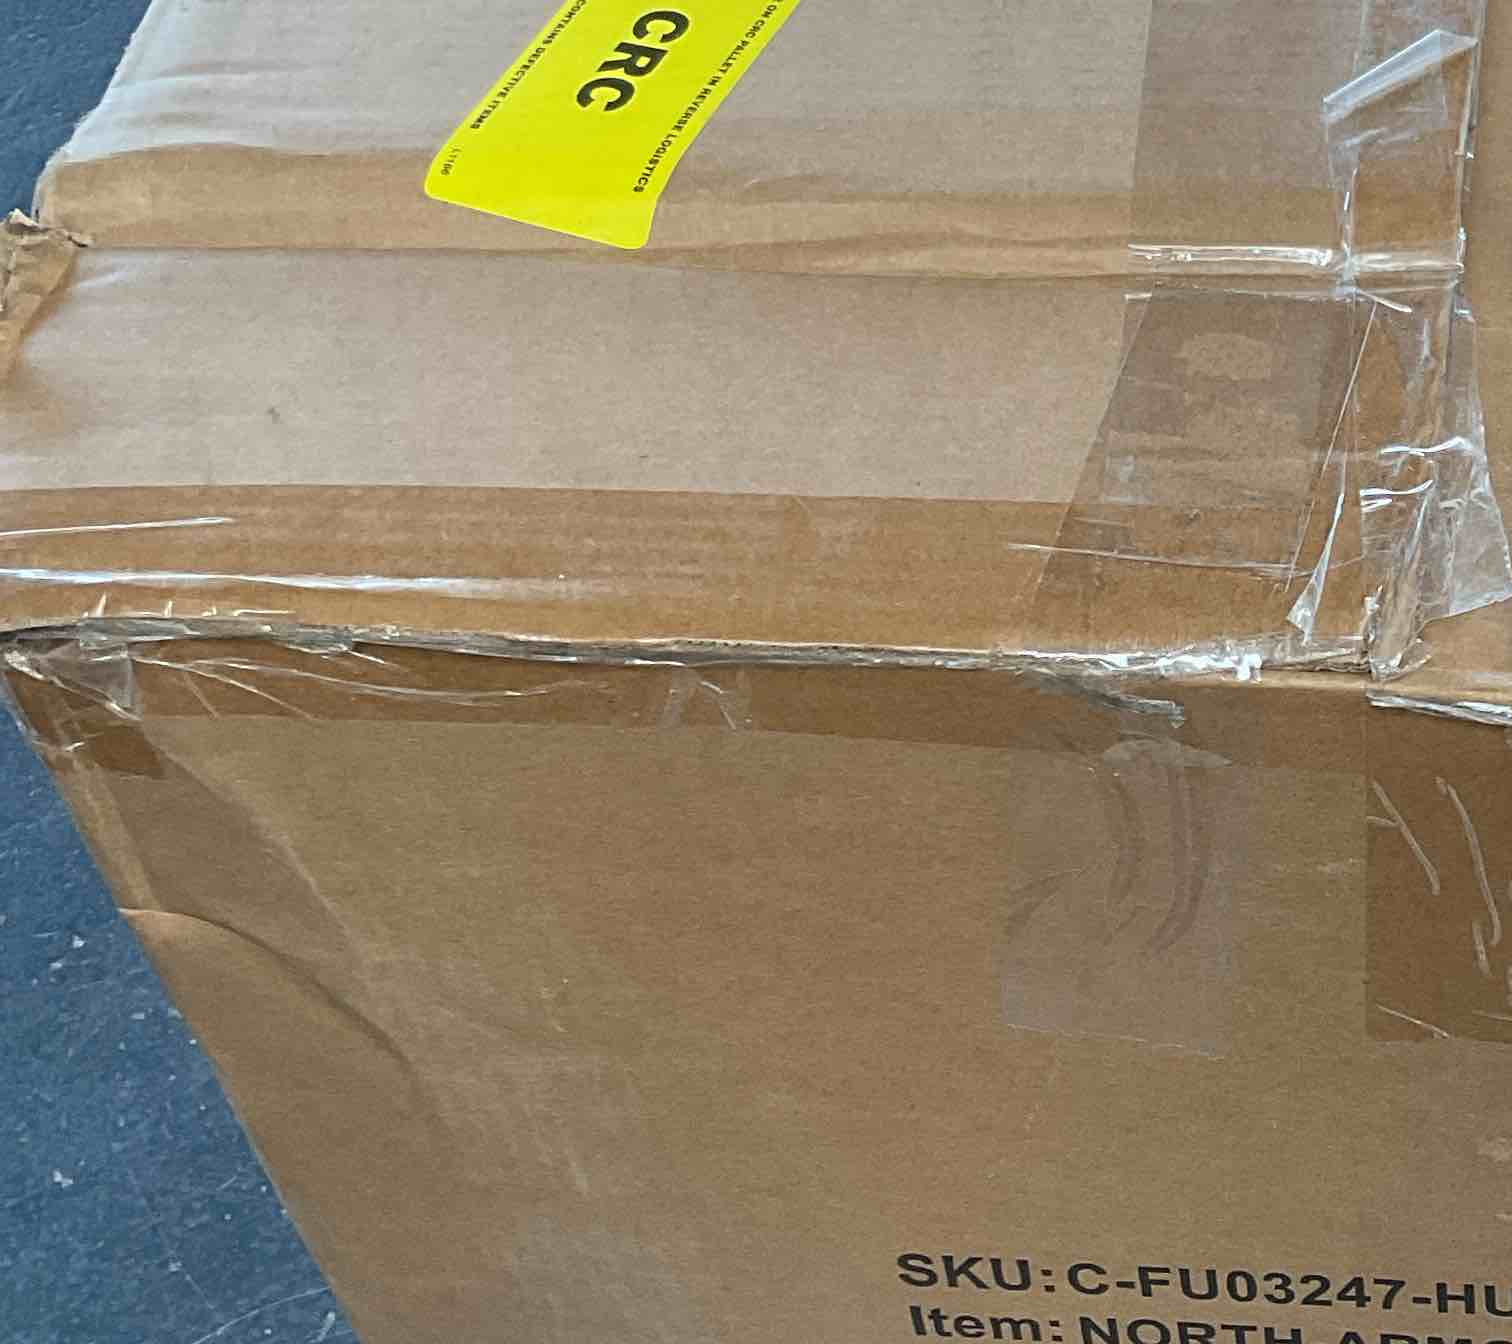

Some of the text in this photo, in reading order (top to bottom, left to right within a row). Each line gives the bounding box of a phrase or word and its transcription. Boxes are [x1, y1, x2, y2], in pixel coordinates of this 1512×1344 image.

[542, 0, 587, 45] CONTAINS
[745, 19, 766, 39] CRC
[761, 4, 777, 18] ON
[497, 47, 546, 98] DEFECTIVE
[575, 10, 690, 112] CRC
[718, 40, 750, 74] PALLET
[707, 76, 722, 86] IN
[470, 100, 501, 130] ITEMS
[672, 87, 712, 132] REVERSE
[633, 133, 678, 193] LOGISTICS
